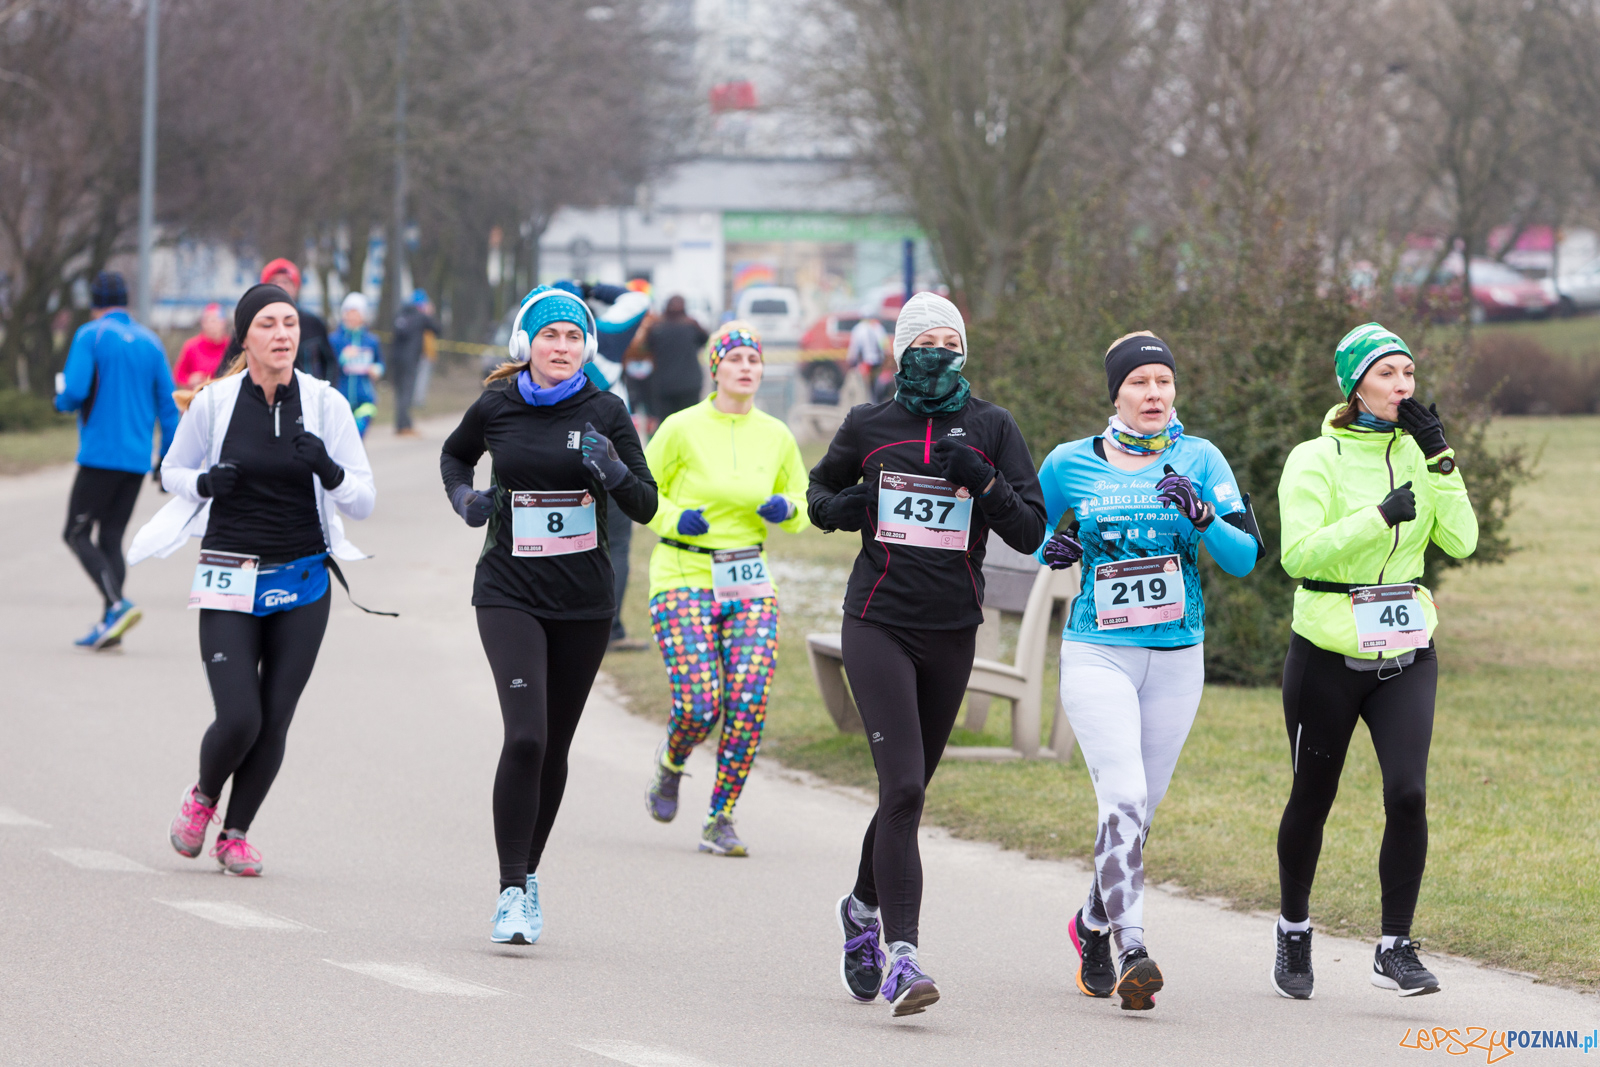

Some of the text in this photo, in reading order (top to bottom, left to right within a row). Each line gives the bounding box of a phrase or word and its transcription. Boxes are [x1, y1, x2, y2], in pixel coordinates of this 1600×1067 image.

[567, 431, 575, 449] RUN
[1093, 480, 1120, 493] Bieg
[1102, 495, 1131, 506] BIEG
[893, 496, 955, 525] 437
[1096, 513, 1179, 523] Gniezno, 17.09.2017
[547, 512, 564, 533] 8
[881, 530, 905, 539] 11.02.2018
[201, 569, 233, 589] 15
[727, 562, 765, 582] 182
[264, 592, 298, 607] Enea
[1111, 578, 1167, 605] 219
[1103, 617, 1127, 625] 11.02.2018
[1379, 604, 1410, 627] 46
